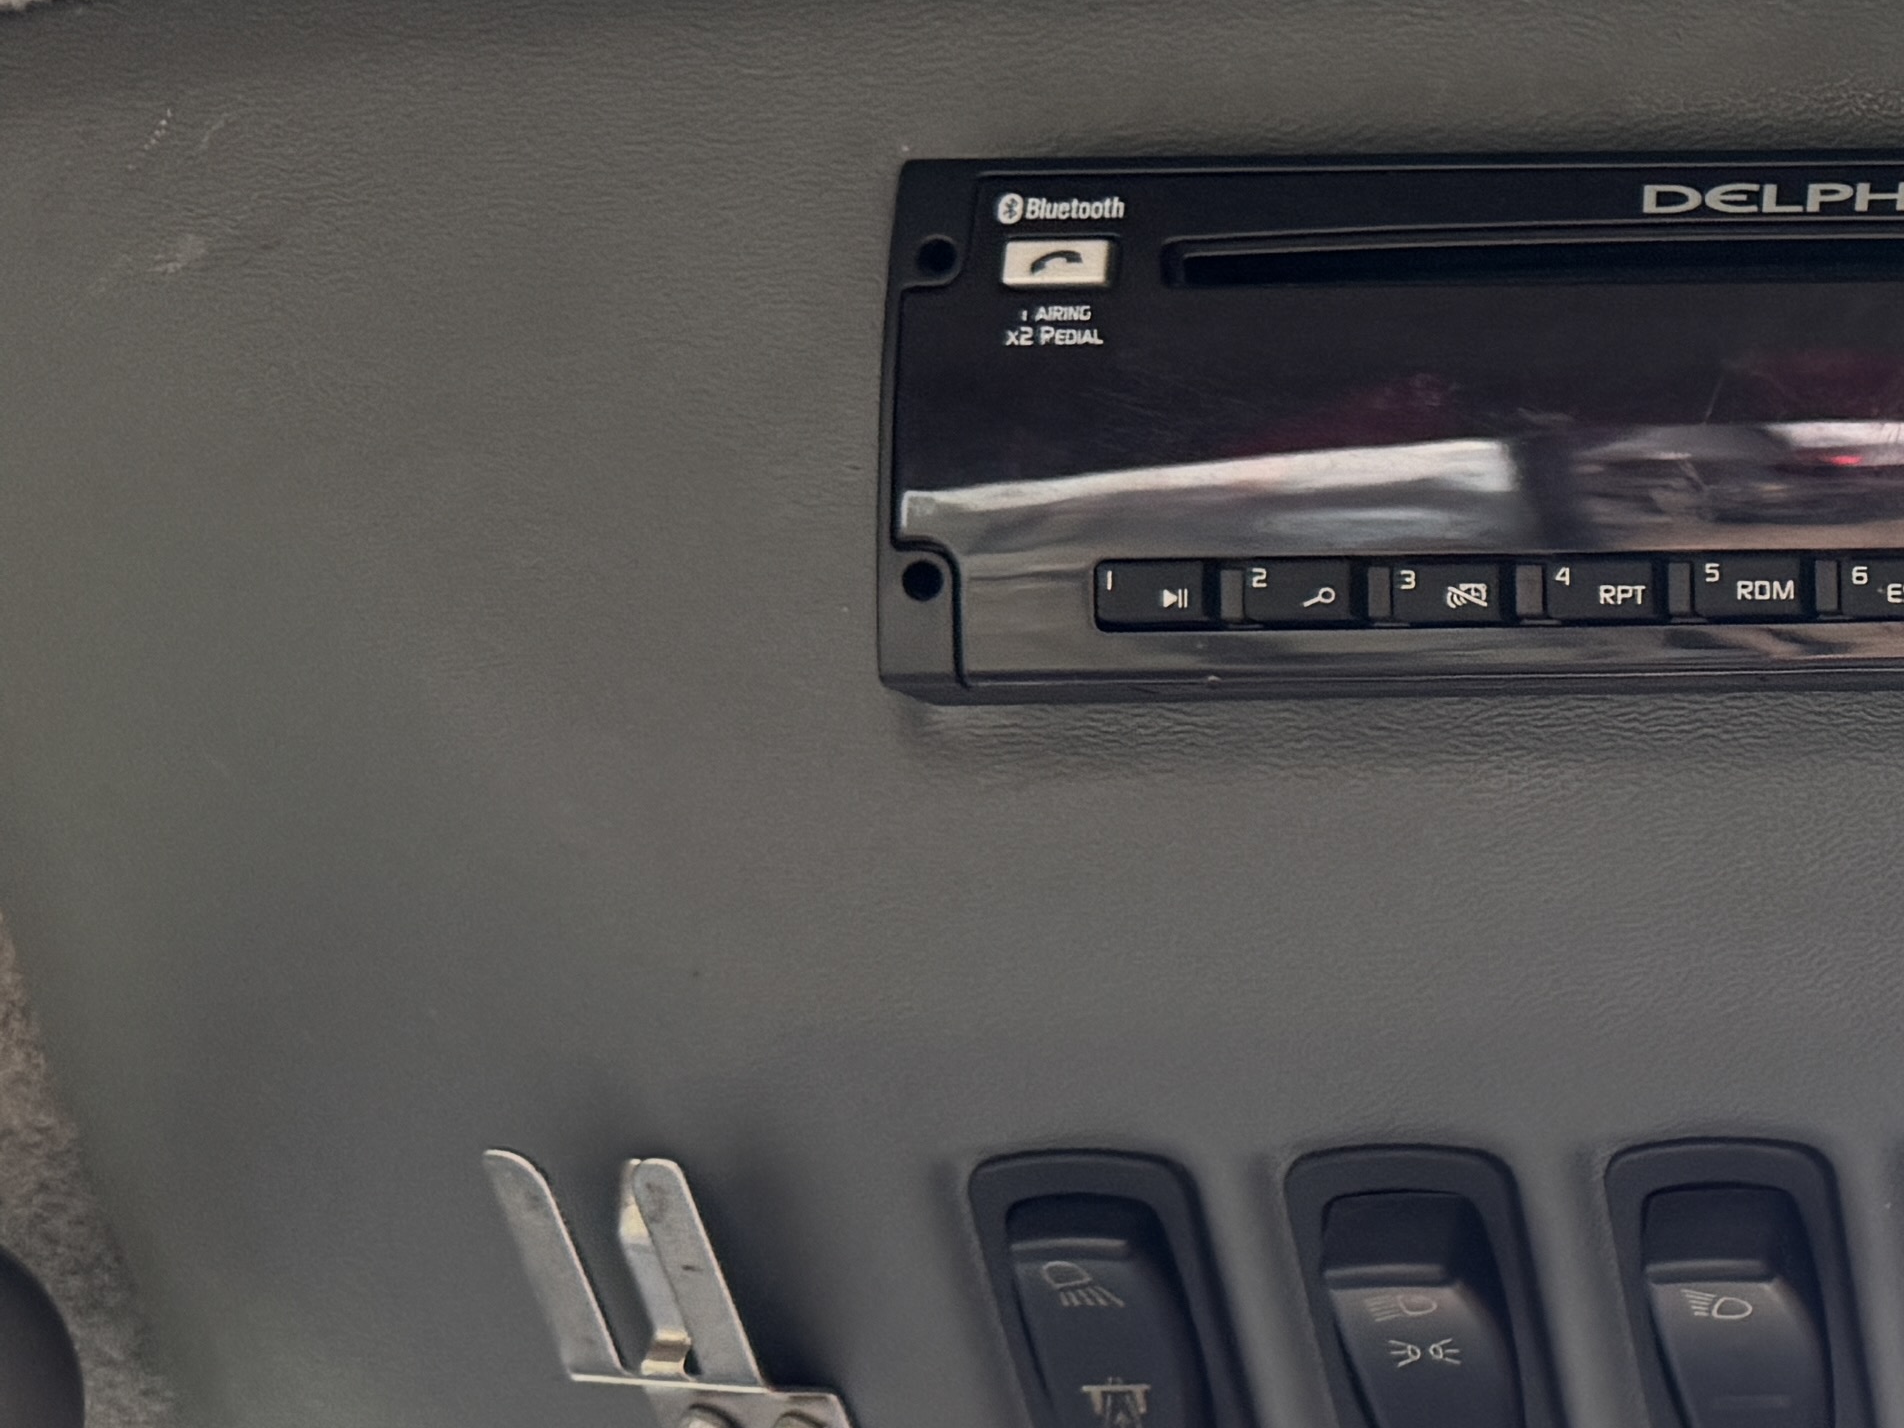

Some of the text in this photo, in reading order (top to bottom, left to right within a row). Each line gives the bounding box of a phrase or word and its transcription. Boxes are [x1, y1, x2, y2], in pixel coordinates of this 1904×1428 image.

[1025, 196, 1125, 220] Bluetooth
[1005, 326, 1034, 346] x2
[1251, 567, 1268, 588] 2
[1400, 569, 1416, 590] 3
[1554, 566, 1570, 586] 4
[1704, 562, 1720, 583] 5
[1851, 565, 1868, 585] 6
[1599, 584, 1646, 605] RPT
[1736, 579, 1795, 601] RDM
